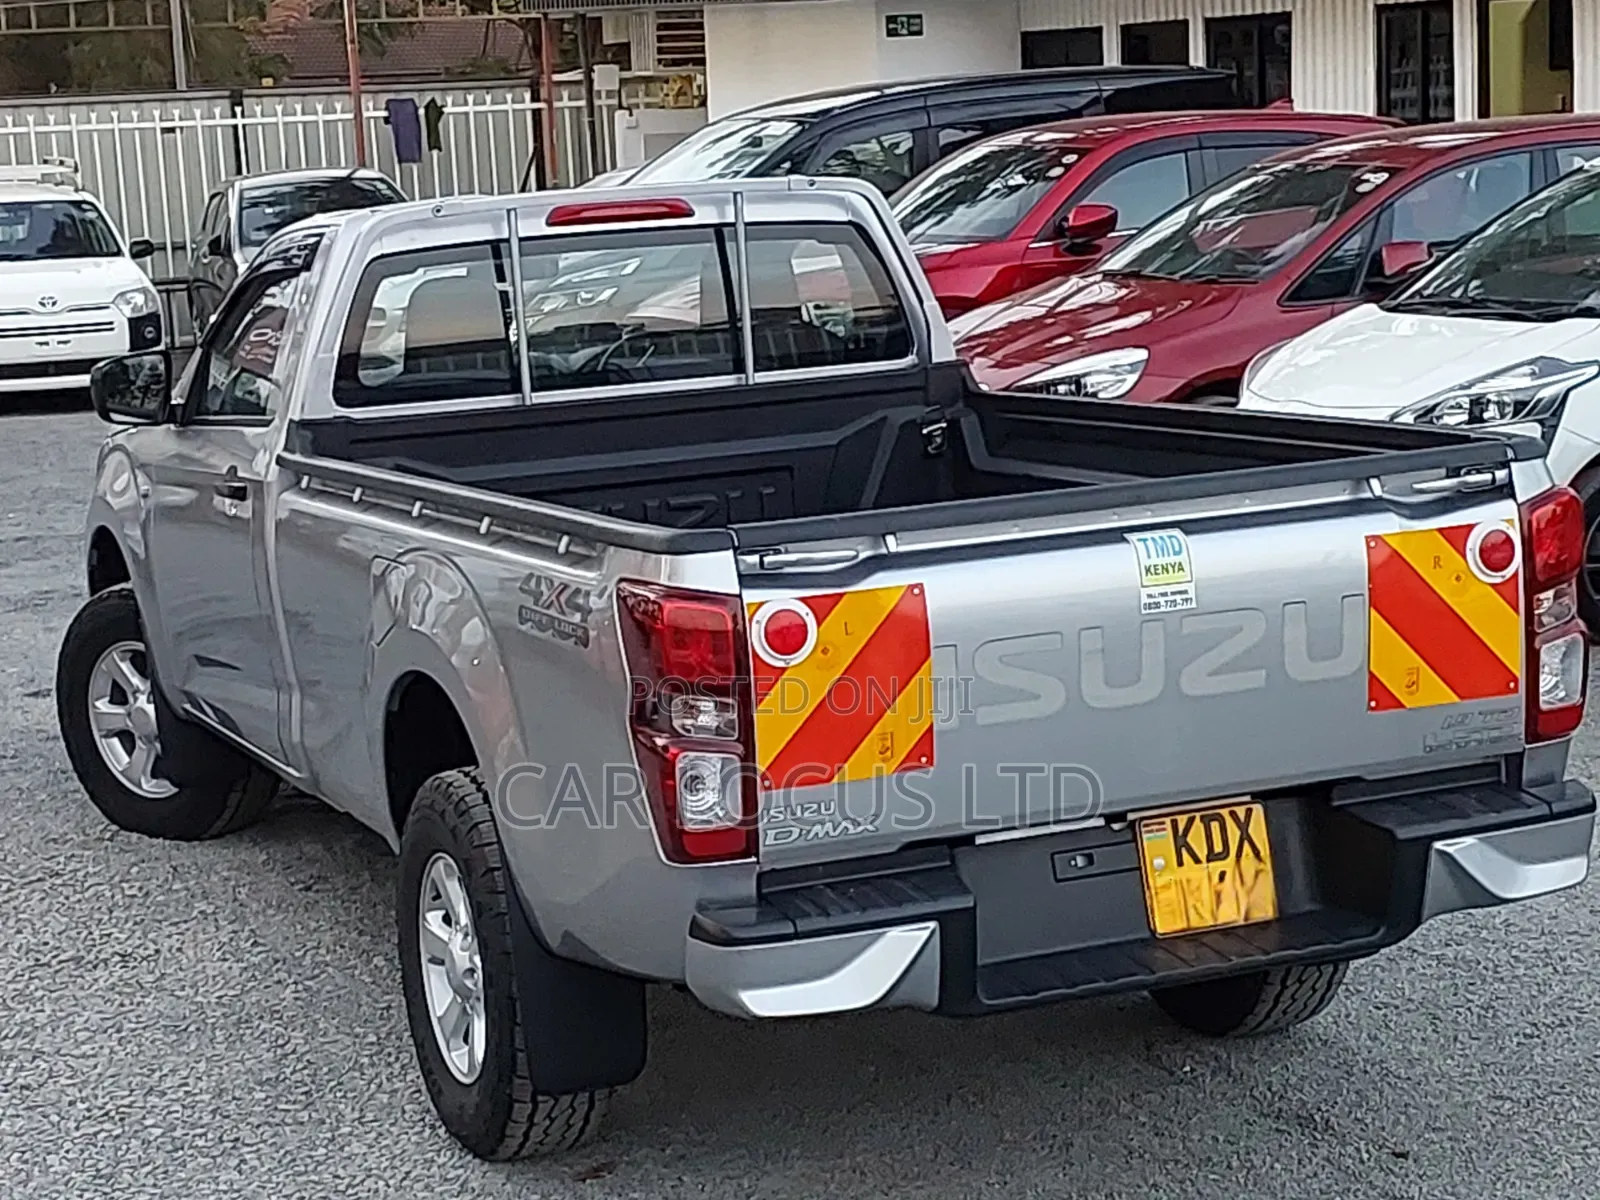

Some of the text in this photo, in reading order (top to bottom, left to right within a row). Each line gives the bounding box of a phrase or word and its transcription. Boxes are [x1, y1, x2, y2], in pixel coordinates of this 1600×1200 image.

[1136, 534, 1184, 560] TMD
[1144, 561, 1186, 577] KENYA
[519, 571, 593, 624] 4X4
[932, 594, 1366, 731] ISUZU
[763, 800, 835, 823] ISUZU
[1170, 807, 1262, 867] KDX
